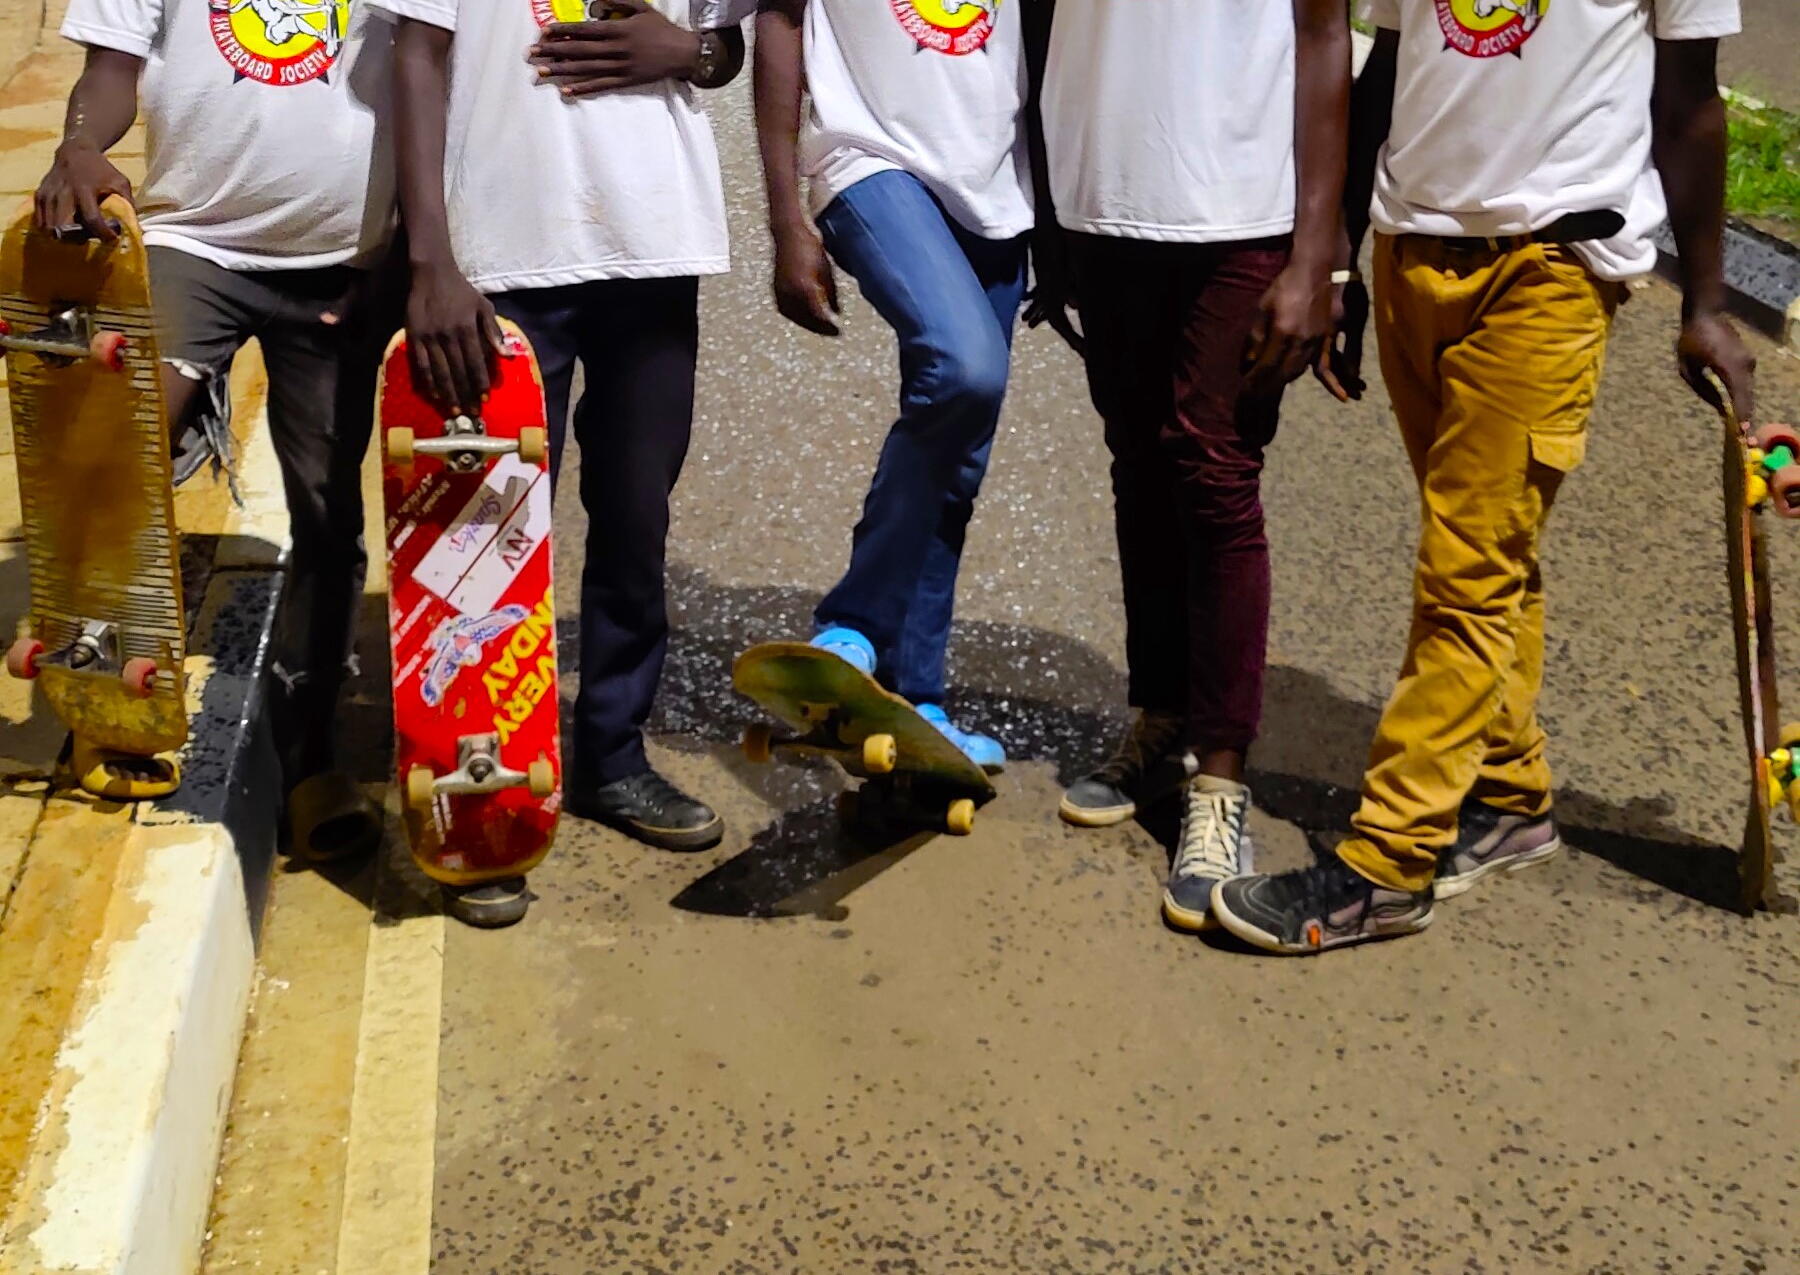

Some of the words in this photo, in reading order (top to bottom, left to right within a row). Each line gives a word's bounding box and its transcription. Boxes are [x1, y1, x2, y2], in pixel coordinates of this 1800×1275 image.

[212, 16, 273, 80] SKATEBOARD
[279, 49, 328, 83] SOCIETY
[1477, 24, 1524, 56] SOCIETY
[502, 527, 534, 571] NTV
[492, 637, 555, 746] VERY
